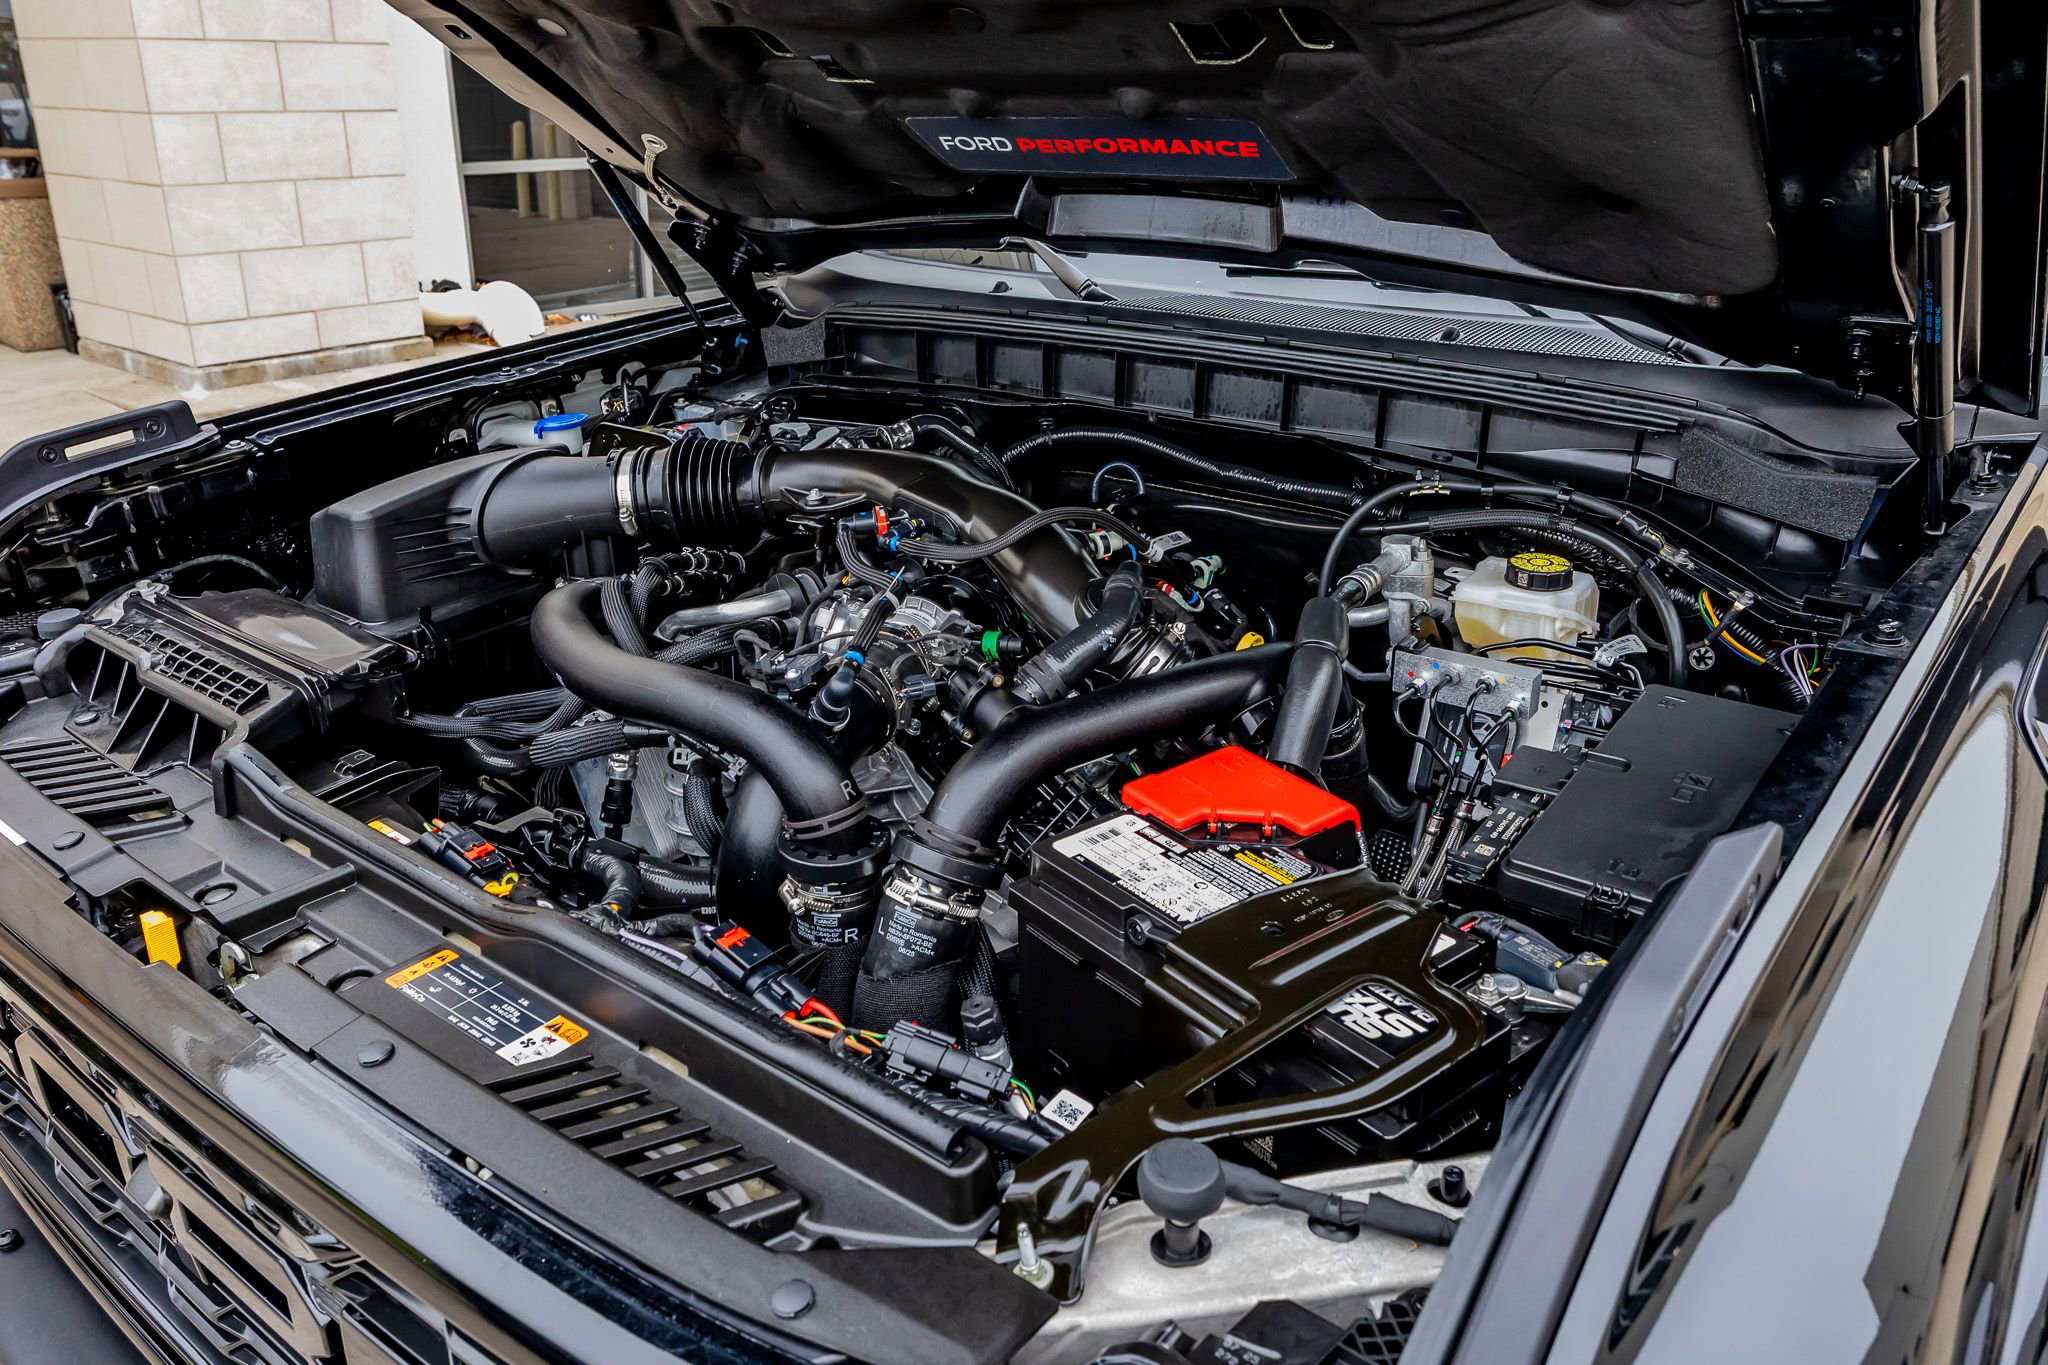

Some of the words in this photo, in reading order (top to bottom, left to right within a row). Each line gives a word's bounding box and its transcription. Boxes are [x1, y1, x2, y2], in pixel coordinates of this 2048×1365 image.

[939, 136, 1012, 152] FORD
[1016, 137, 1259, 158] PERFORMANCE
[840, 779, 856, 800] R
[844, 928, 859, 943] R
[878, 916, 885, 936] L
[889, 920, 902, 931] Made
[909, 929, 937, 943] Romania
[399, 983, 426, 1002] FoMoCo
